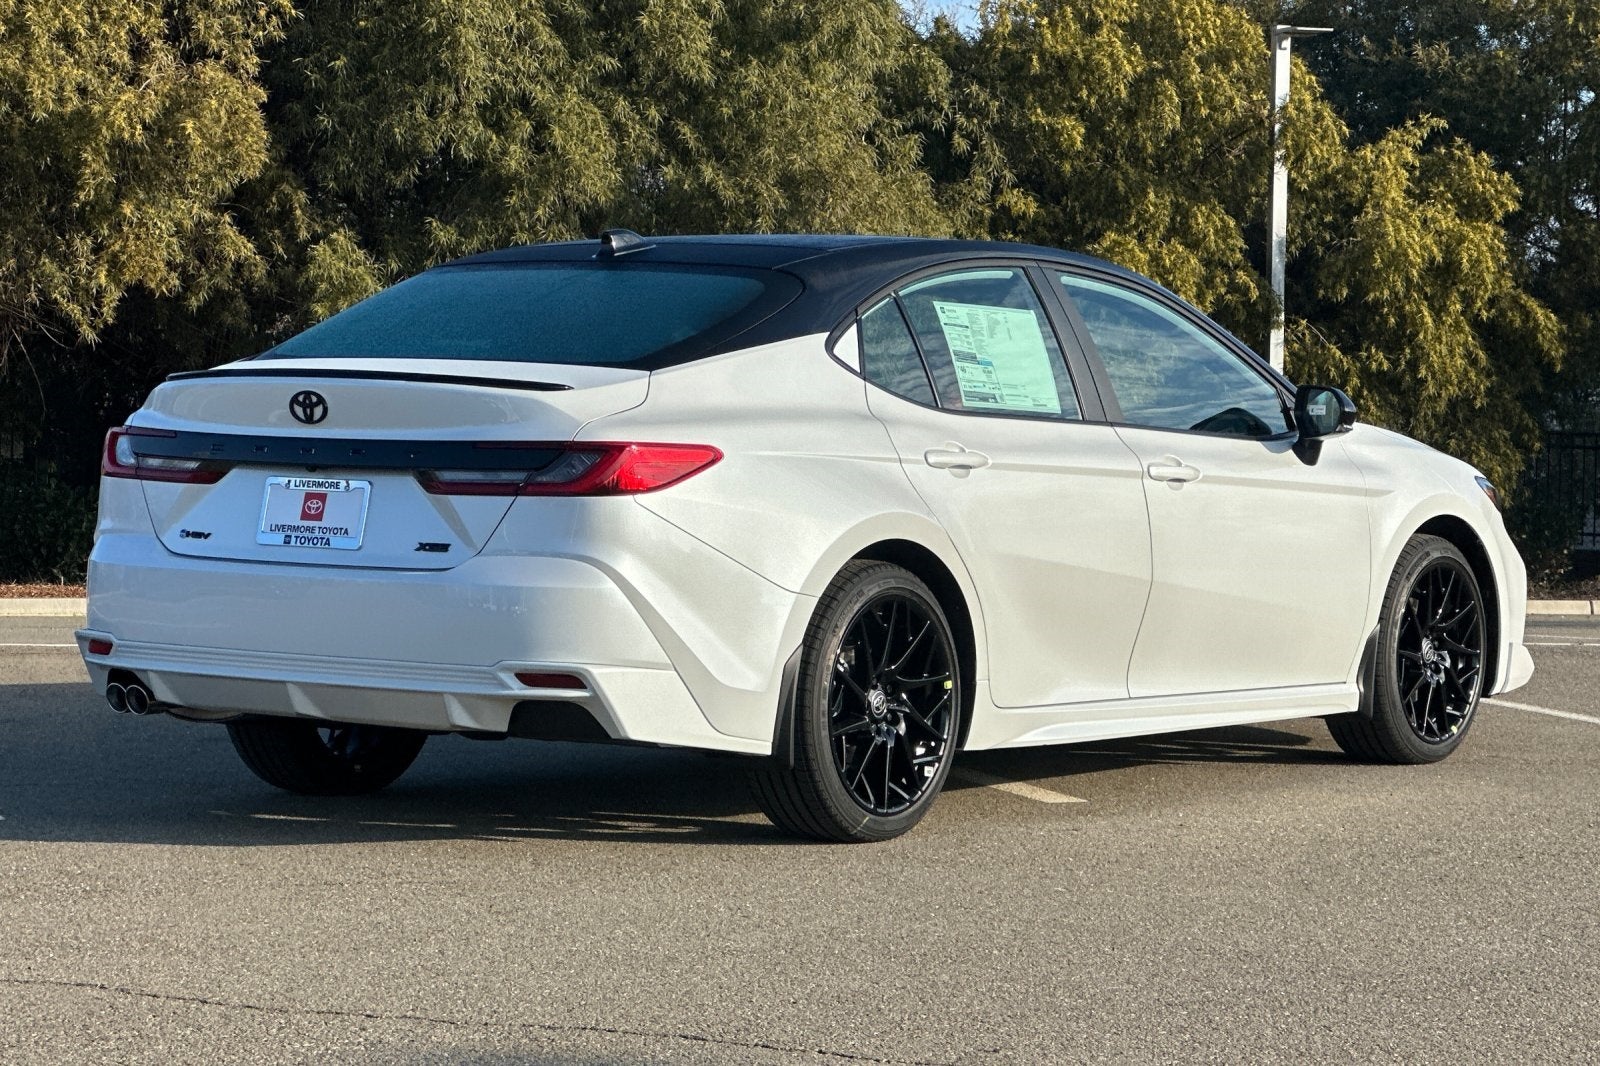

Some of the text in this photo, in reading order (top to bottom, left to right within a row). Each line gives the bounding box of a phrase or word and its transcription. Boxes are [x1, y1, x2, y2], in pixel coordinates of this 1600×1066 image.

[294, 480, 341, 490] LIVERMORE
[269, 523, 349, 536] LIVERMORE TOYOTA
[293, 536, 331, 547] TOYOTA
